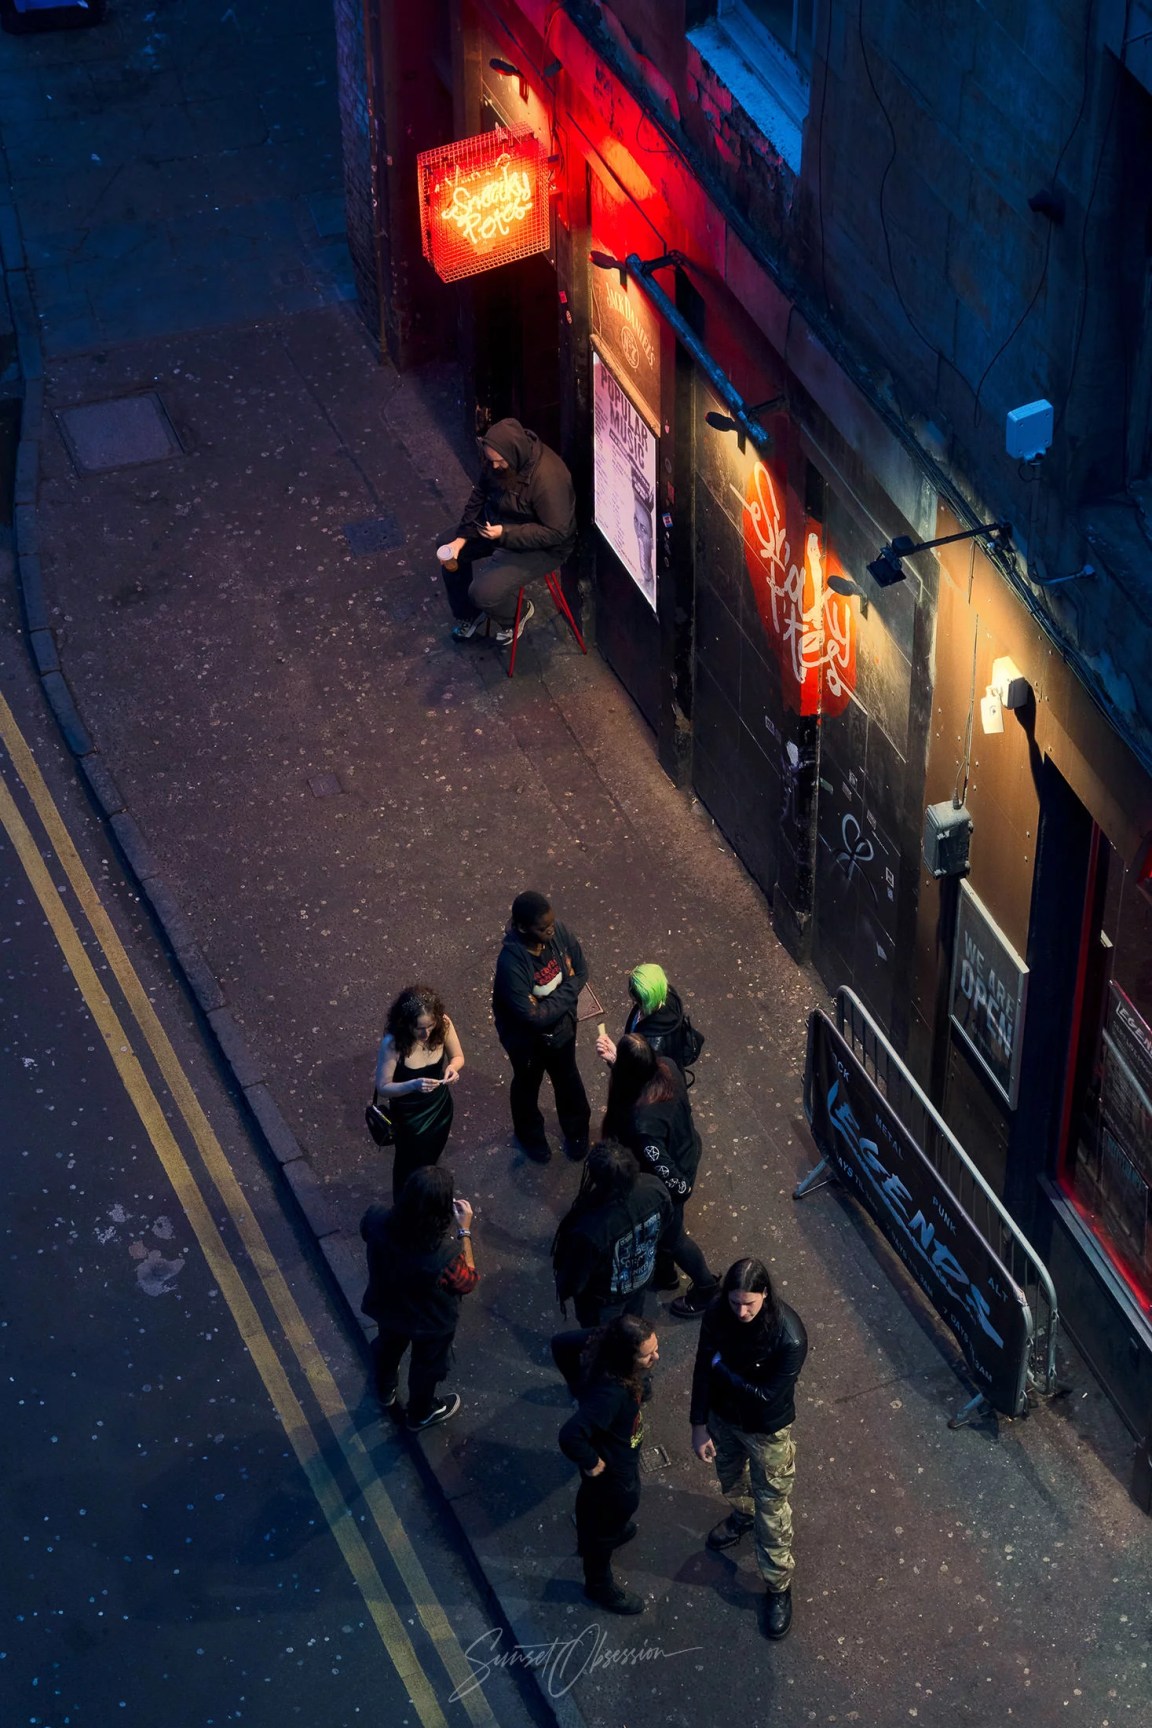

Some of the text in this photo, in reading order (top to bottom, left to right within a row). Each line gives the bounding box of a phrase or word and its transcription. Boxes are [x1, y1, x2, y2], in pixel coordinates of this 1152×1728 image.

[605, 281, 626, 315] JACK
[624, 295, 656, 367] DANIEL'S
[601, 363, 648, 452] POPULAR
[609, 402, 645, 470] MUSIC
[960, 958, 1013, 1060] OPEN
[964, 930, 1016, 1020] WE ARE
[826, 1078, 1005, 1350] LEGENDS
[831, 1052, 1009, 1303] OCK METAL PUNK ALT
[950, 1313, 969, 1344] DAYS
